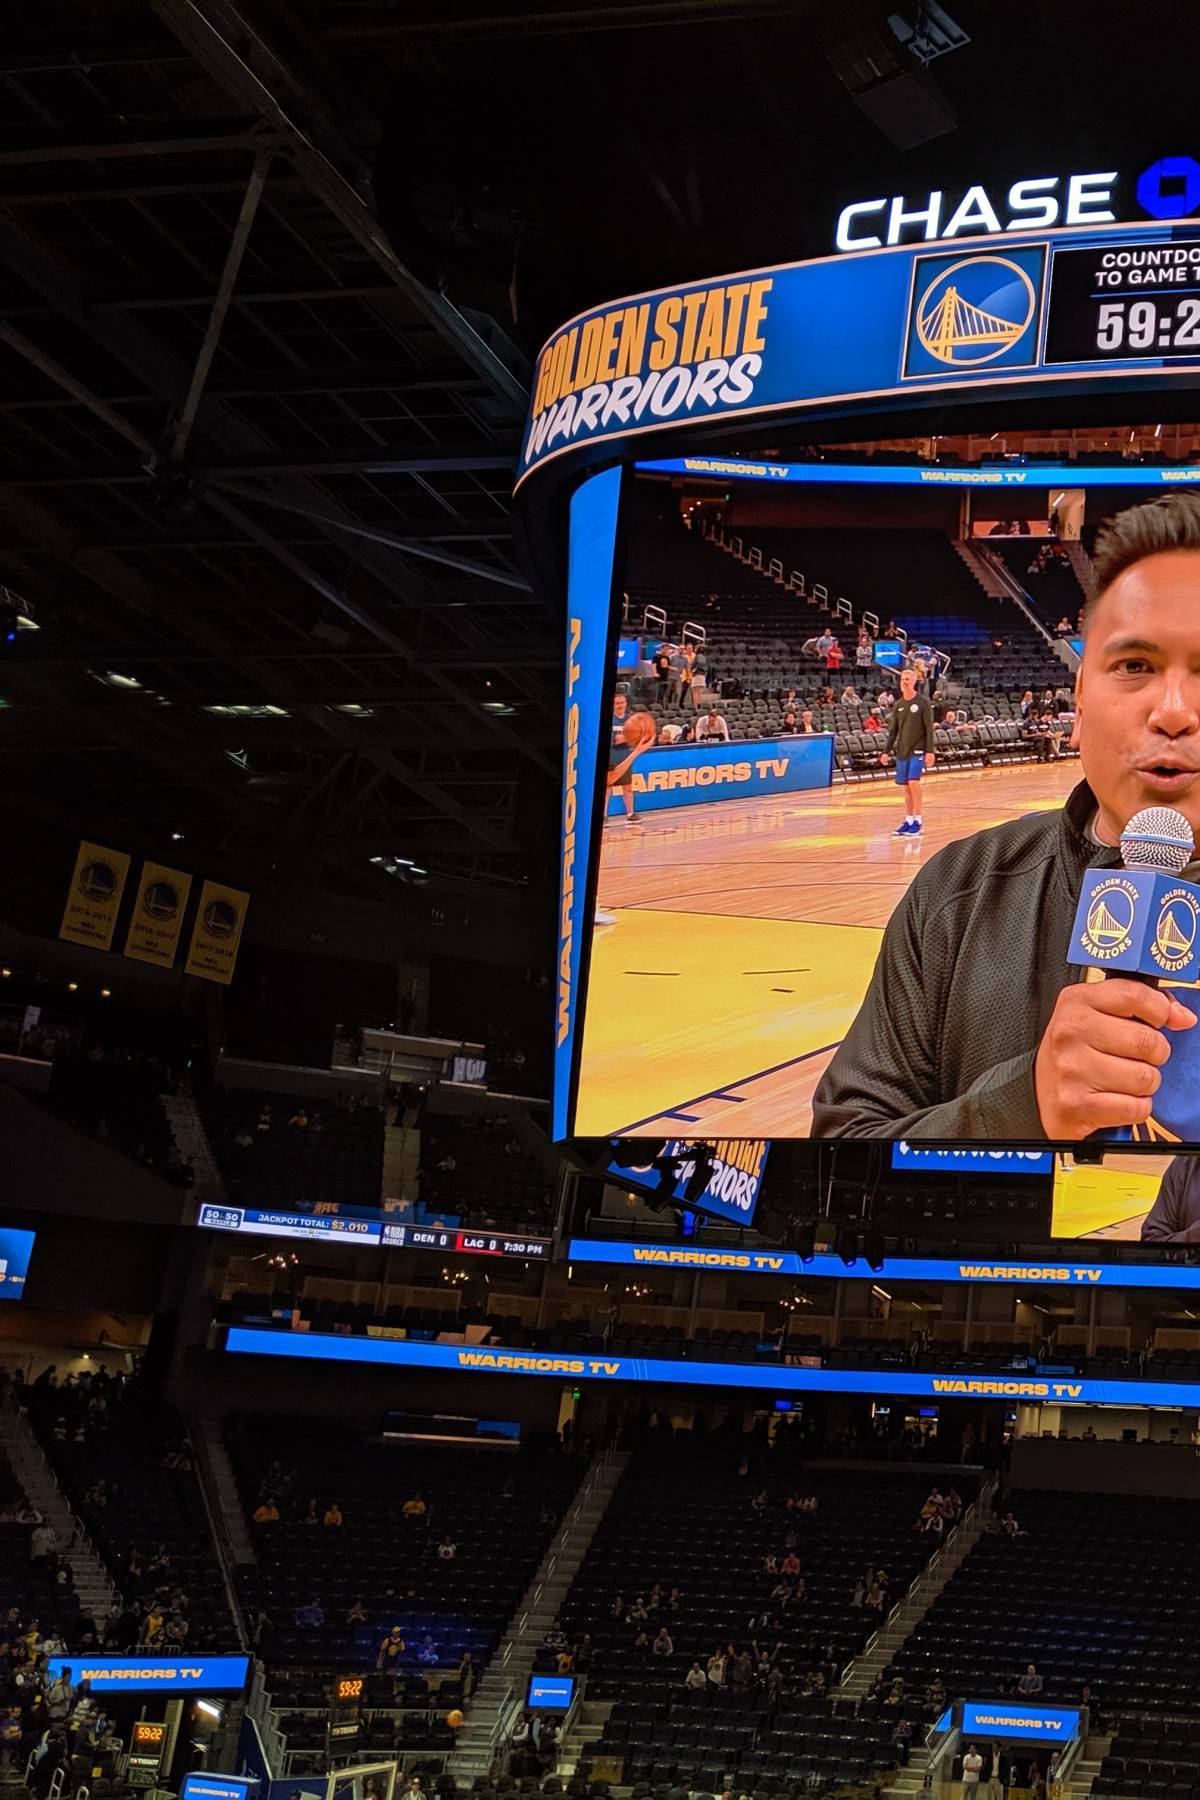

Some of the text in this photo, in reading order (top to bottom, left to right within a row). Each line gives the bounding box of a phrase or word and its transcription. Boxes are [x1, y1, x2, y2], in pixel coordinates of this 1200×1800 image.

[836, 171, 1119, 251] CHASE
[1095, 271, 1124, 287] TO
[1127, 266, 1188, 284] GAME
[534, 277, 773, 420] GOLDEN STATE
[523, 353, 763, 465] WARRIORS
[684, 458, 789, 477] WARRIORS TV
[920, 470, 1027, 484] WARRIORS TV
[755, 757, 790, 779] TV
[556, 617, 582, 1049] WARRIORS TV
[1090, 877, 1140, 901] GOLDEN STATE
[1160, 887, 1200, 915] GOLDEN STATE
[1079, 931, 1133, 960] WARRIORS
[1150, 941, 1195, 972] WARRIORS
[206, 1209, 239, 1222] 50 50
[258, 1213, 299, 1226] JACKPOT
[299, 1218, 329, 1229] TOTAL:
[413, 1232, 544, 1255] DEN 0 LAC 0 7:30 PM
[632, 1248, 784, 1270] WARRIORS TV
[959, 1265, 1102, 1282] WARRIORS TV
[457, 1352, 620, 1376] WARRIORS TV
[932, 1379, 1082, 1398] WARRIORS TV
[80, 1667, 204, 1681] WARRIORS TV
[339, 1680, 363, 1697] 59:22
[137, 1726, 163, 1741] 59:22
[975, 1715, 1063, 1730] WARRIORS TV
